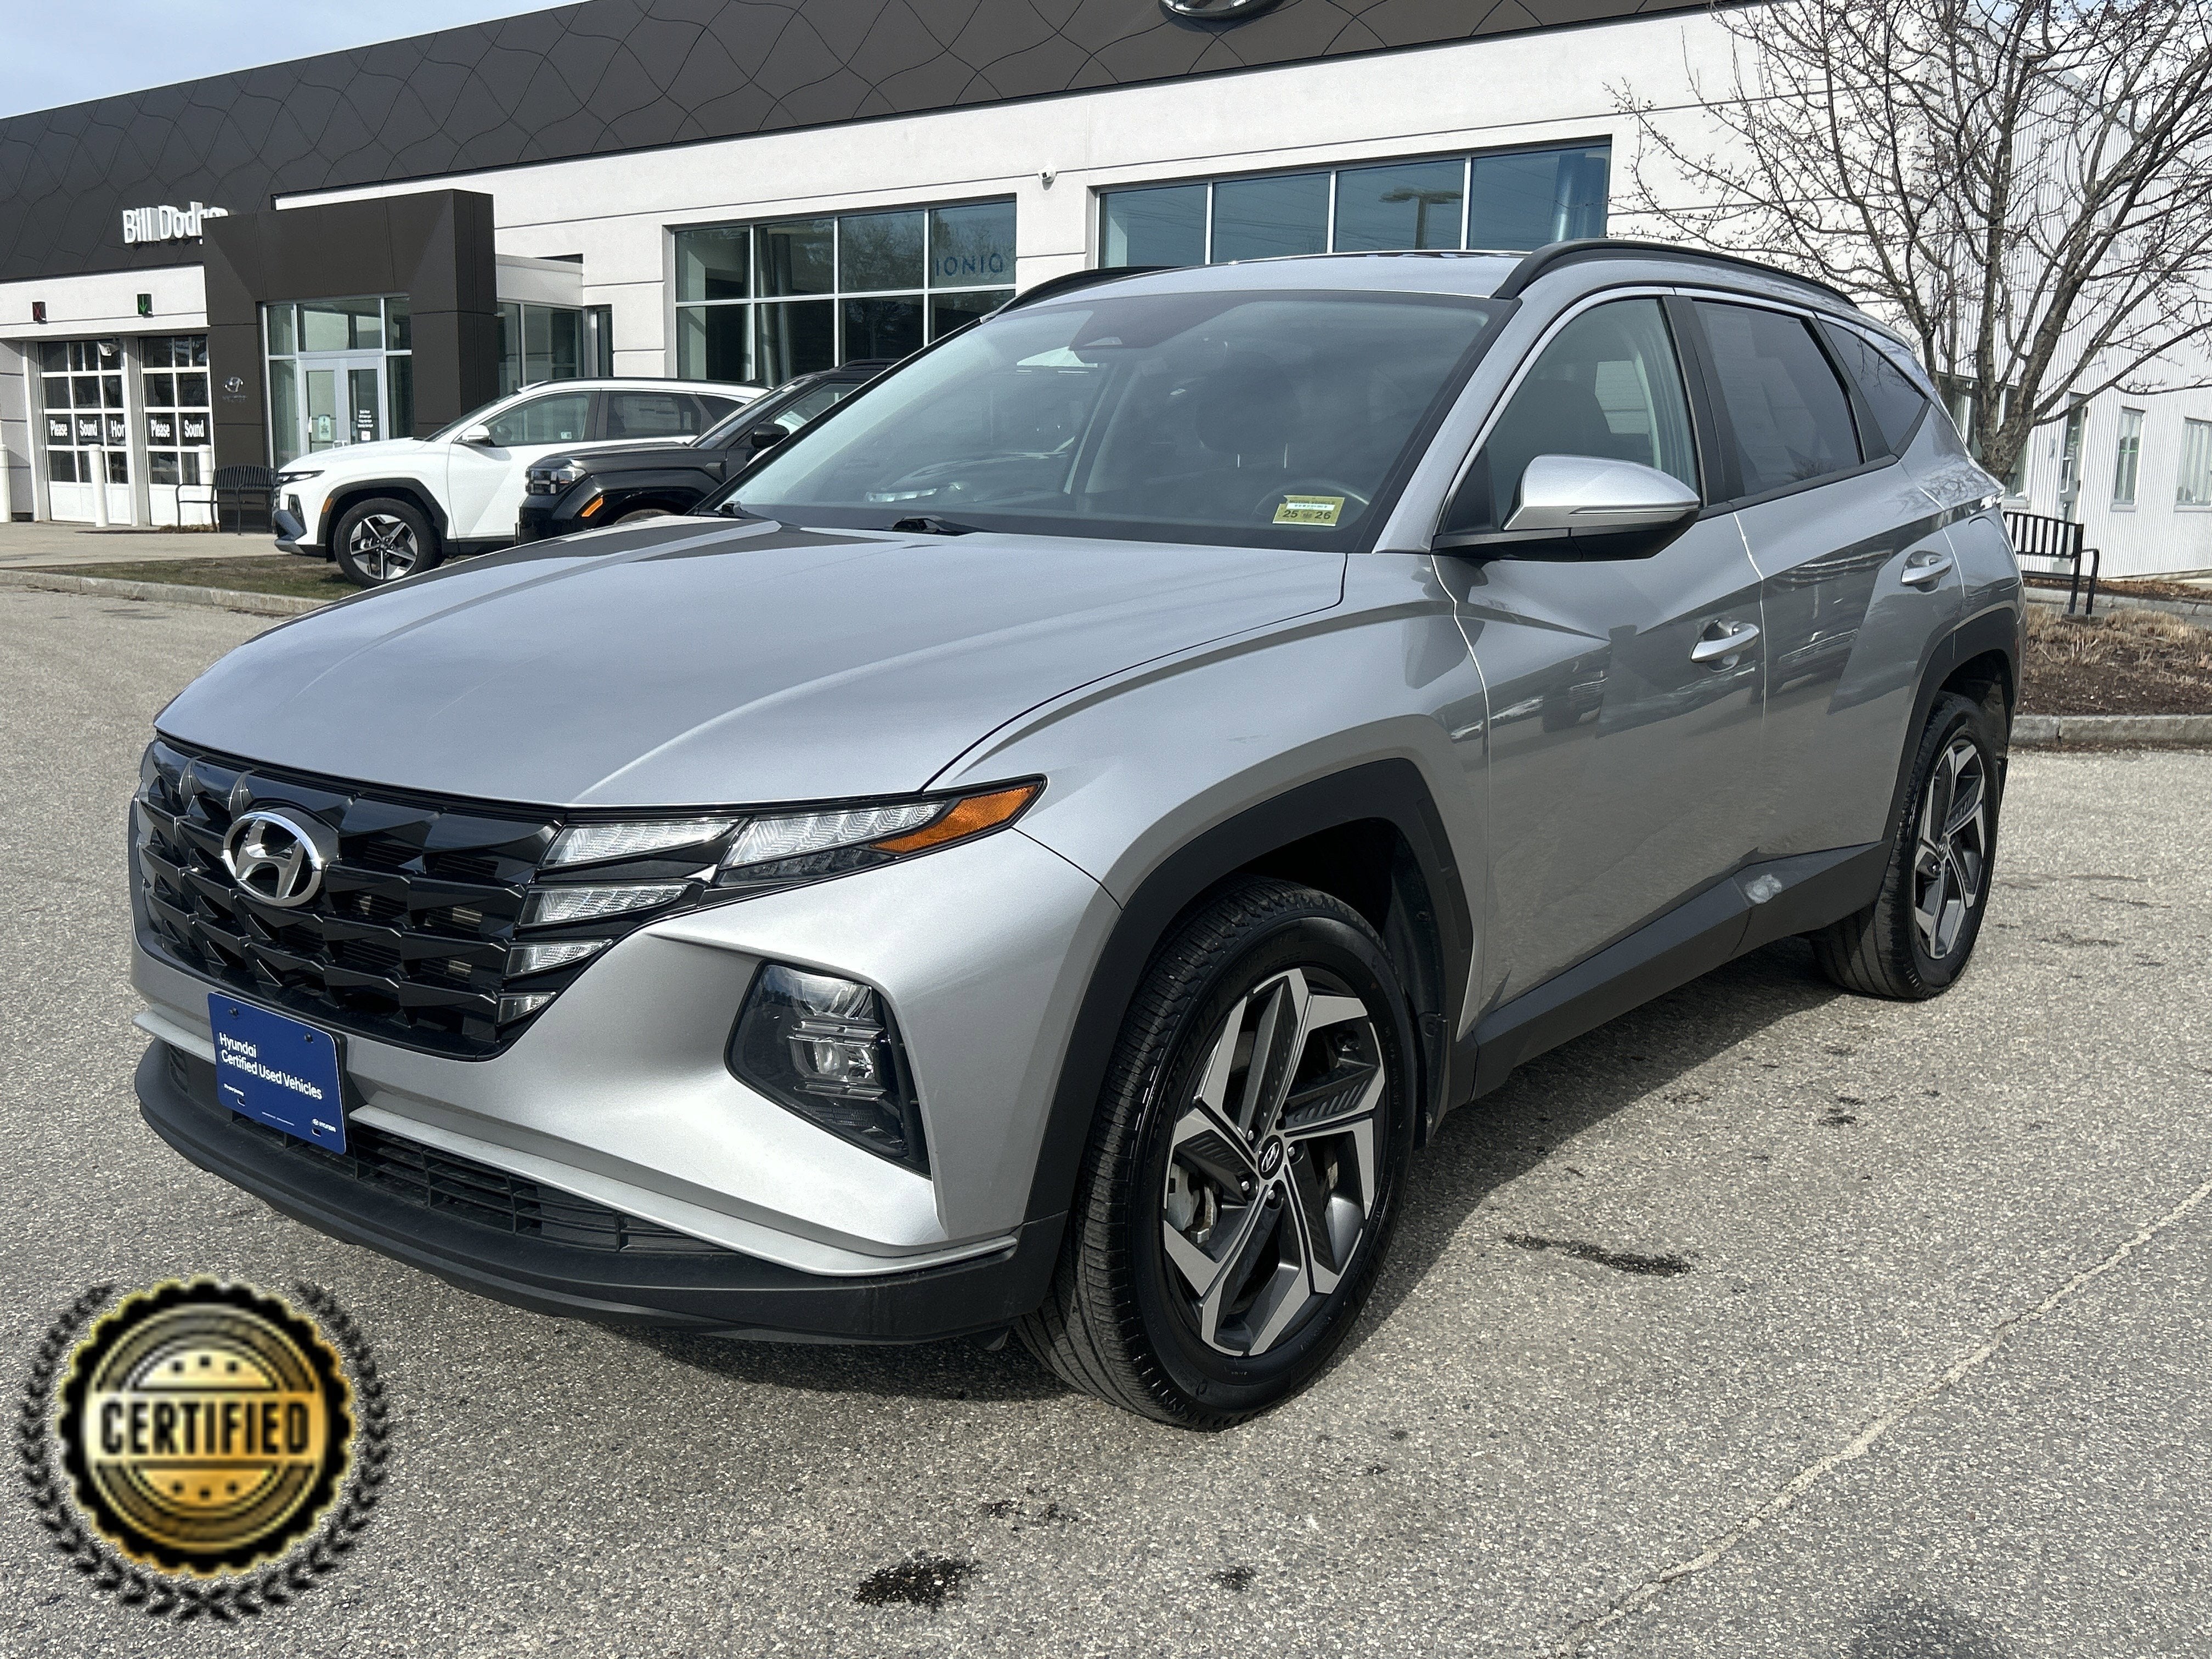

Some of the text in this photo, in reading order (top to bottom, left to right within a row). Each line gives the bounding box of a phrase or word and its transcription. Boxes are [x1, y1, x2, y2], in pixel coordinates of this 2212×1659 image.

[123, 207, 157, 243] Bill
[936, 253, 1003, 276] IONIQ
[50, 419, 125, 437] Please Sound Hor
[151, 419, 205, 437] Please Sound
[1283, 510, 1299, 518] 25
[1314, 511, 1332, 520] 26
[219, 1032, 257, 1058] Hyundai
[221, 1049, 323, 1100] Certified Used Vehicles
